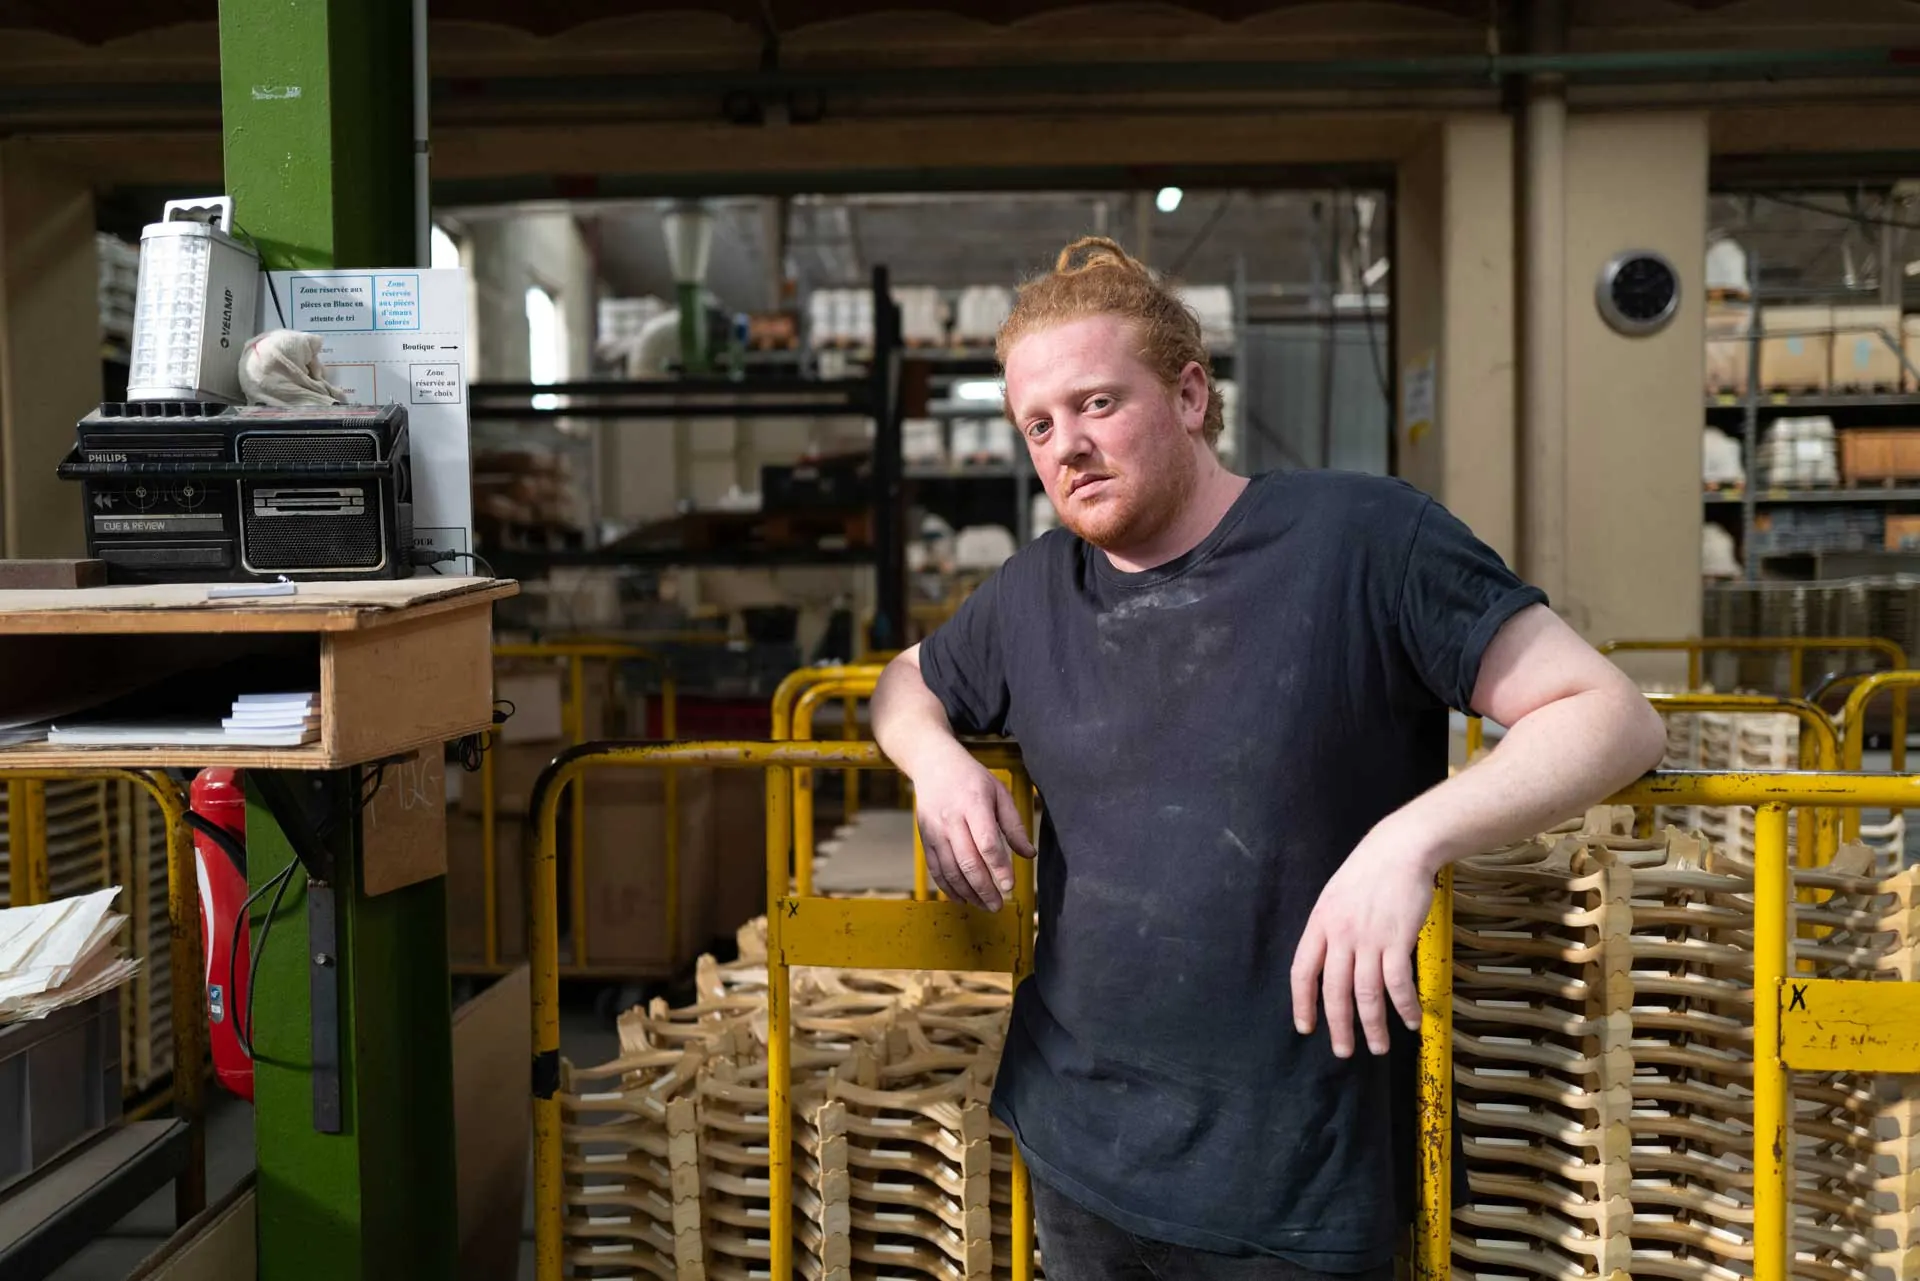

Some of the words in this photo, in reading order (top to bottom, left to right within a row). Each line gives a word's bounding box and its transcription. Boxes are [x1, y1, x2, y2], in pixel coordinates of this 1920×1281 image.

[299, 286, 318, 294] Zone
[319, 286, 348, 294] réservée
[382, 289, 411, 297] réservée
[300, 301, 322, 309] pièces
[333, 300, 353, 308] Blanc
[393, 299, 415, 308] pièces
[221, 289, 233, 335] VELAMP
[402, 343, 436, 352] Boutique
[415, 378, 445, 386] réservée
[88, 454, 128, 463] PHILIPS
[103, 522, 122, 531] CUE
[123, 521, 131, 530] &
[131, 521, 166, 531] REVIEW
[413, 538, 434, 546] OUR
